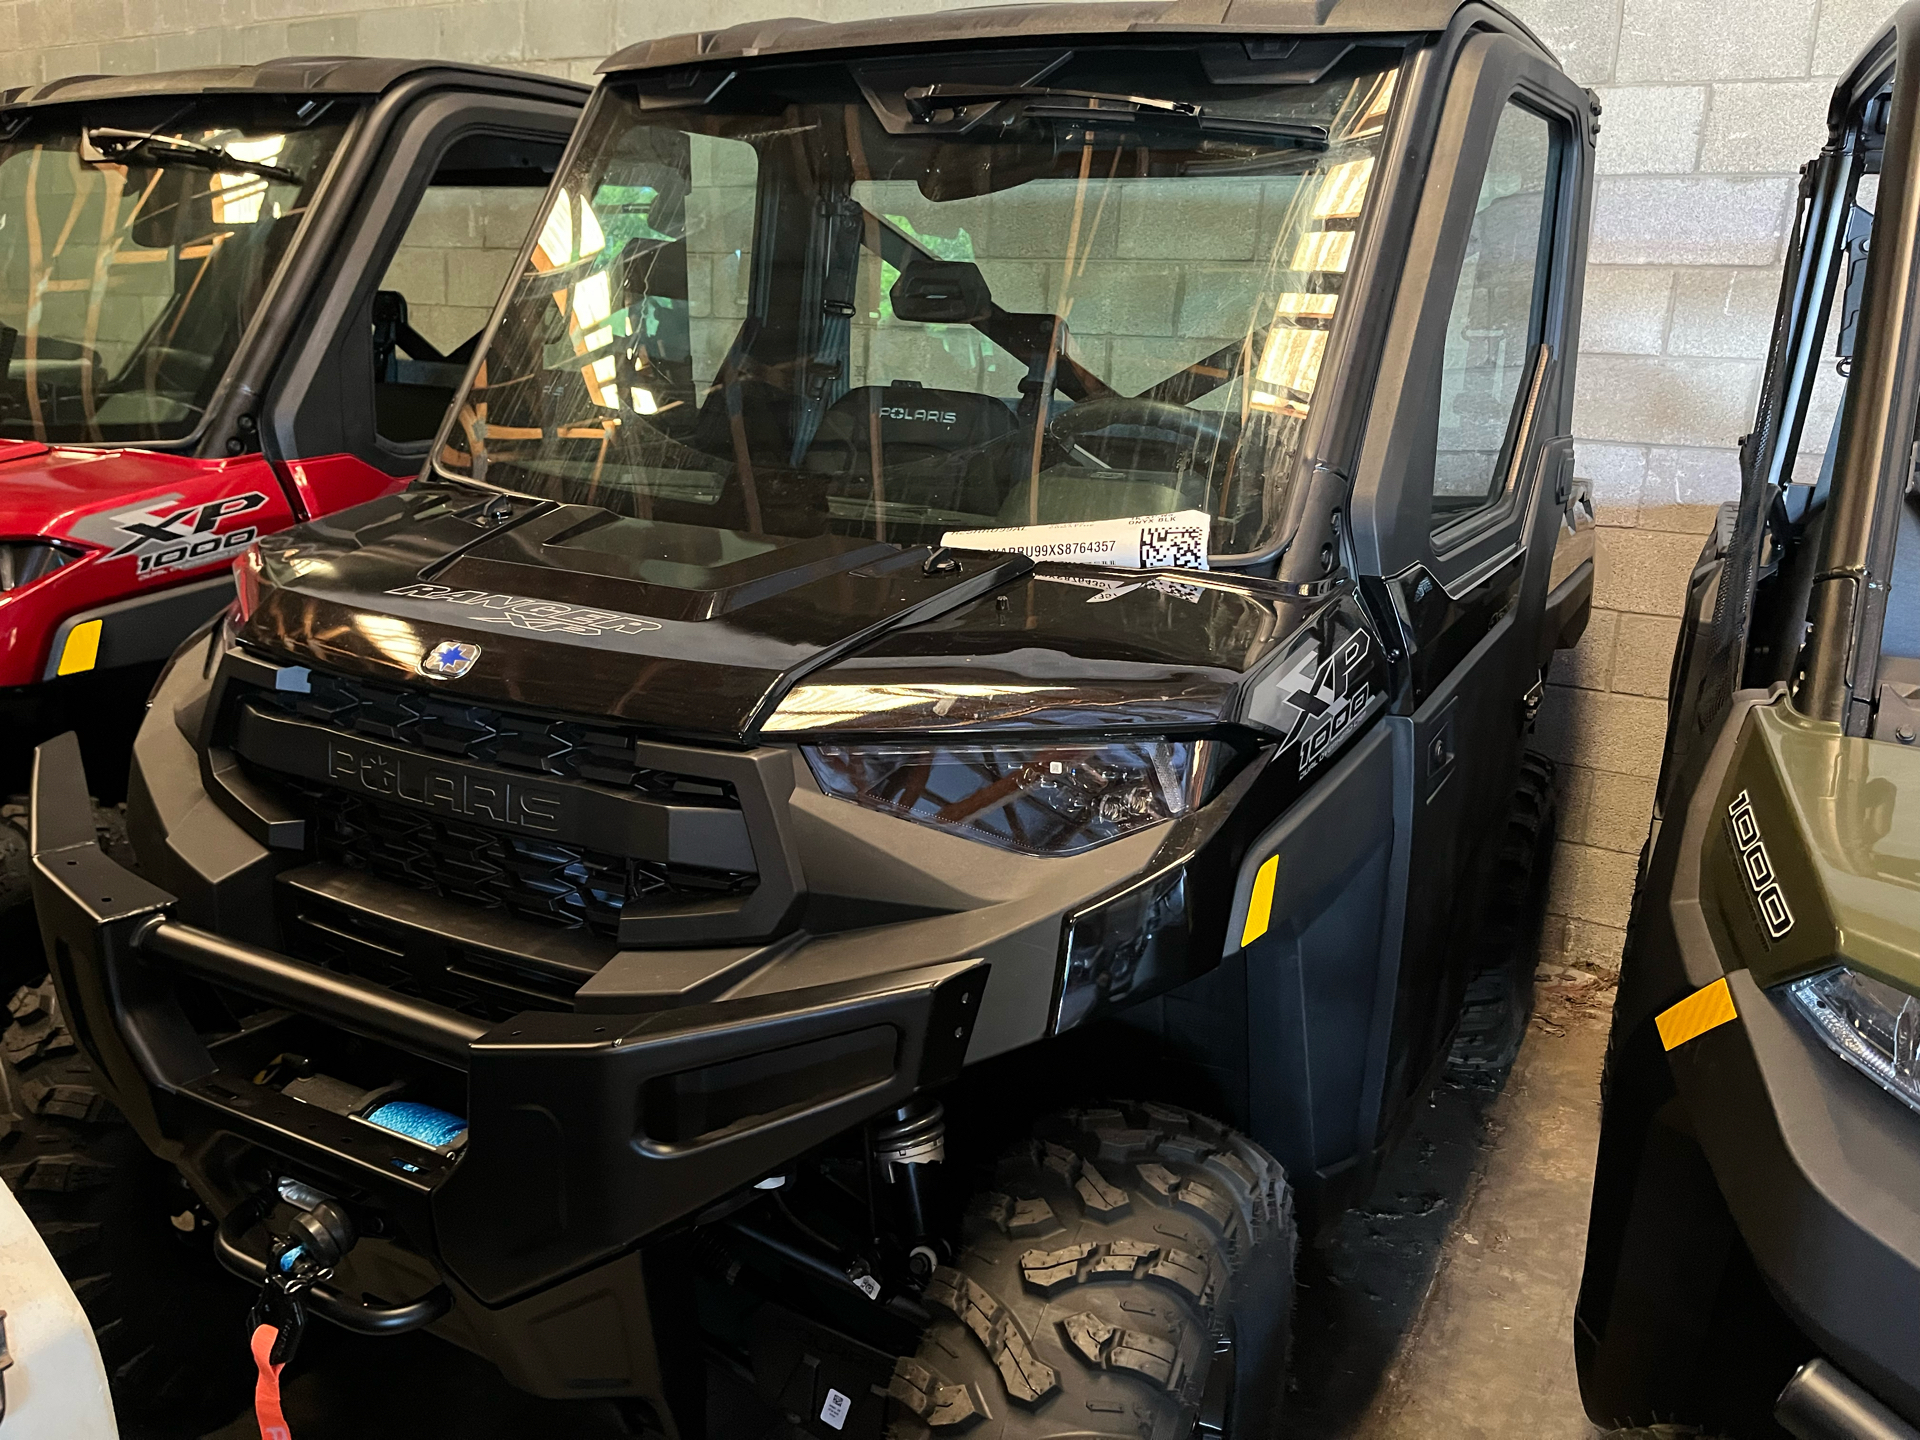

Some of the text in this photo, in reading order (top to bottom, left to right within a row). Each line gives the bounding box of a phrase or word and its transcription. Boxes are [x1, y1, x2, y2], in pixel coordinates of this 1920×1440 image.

[879, 407, 957, 424] POLARIS
[98, 490, 270, 561] XP
[137, 526, 258, 575] 1000
[384, 583, 663, 635] RANGER
[468, 612, 603, 637] XP
[1271, 627, 1371, 763] XP
[1298, 681, 1370, 772] 1000
[328, 740, 562, 832] POLARIS
[1728, 788, 1795, 938] 1000
